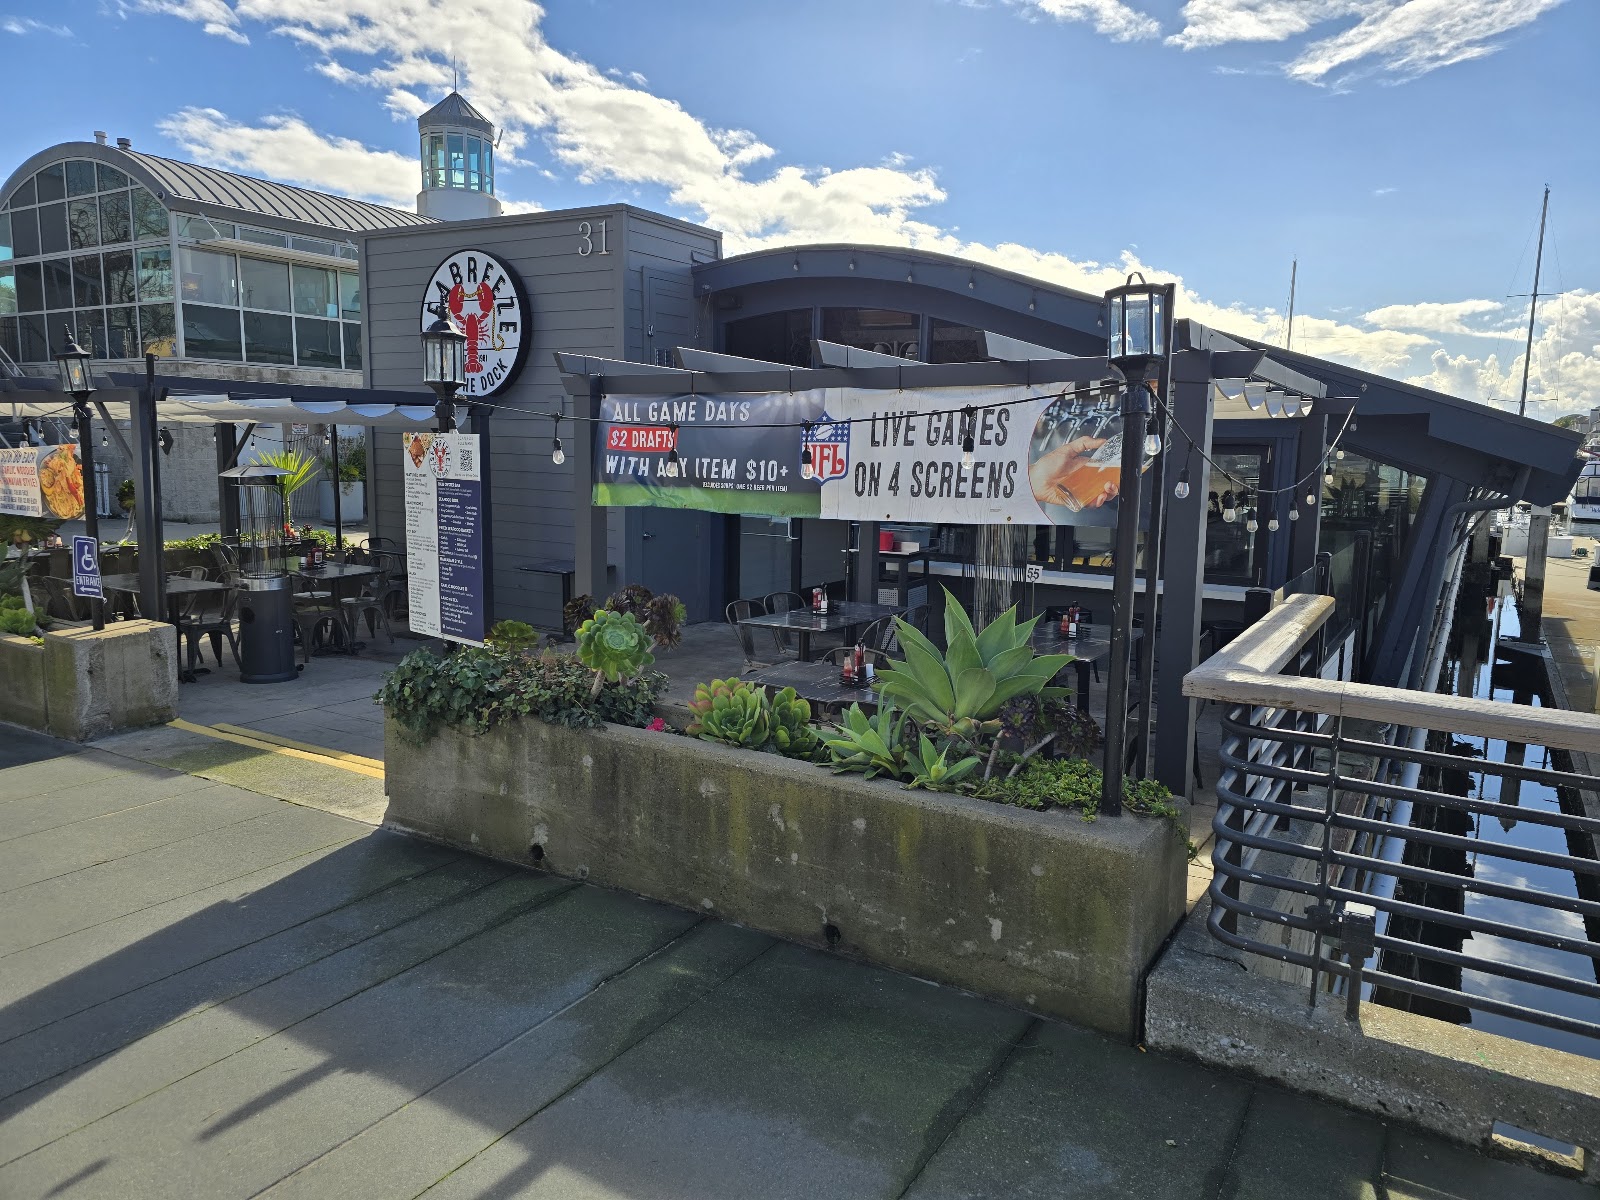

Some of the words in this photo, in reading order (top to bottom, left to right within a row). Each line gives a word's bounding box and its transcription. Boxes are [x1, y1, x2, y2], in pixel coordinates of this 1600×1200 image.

[578, 219, 610, 257] 31
[480, 357, 508, 391] DOCK
[612, 402, 641, 423] ALL
[648, 401, 697, 422] GAME
[704, 400, 751, 422] DAYS
[610, 430, 628, 448] $2
[631, 430, 675, 449] DRAFTS
[870, 410, 917, 448] LIVE
[926, 407, 1011, 447] GAMES
[605, 454, 649, 477] WITH
[656, 456, 688, 478] AY
[695, 457, 737, 480] ITEM
[746, 458, 789, 482] $10+
[854, 461, 881, 498] ON
[888, 461, 901, 497] 4
[910, 460, 1018, 499] SCREENS
[1027, 567, 1040, 581] 55
